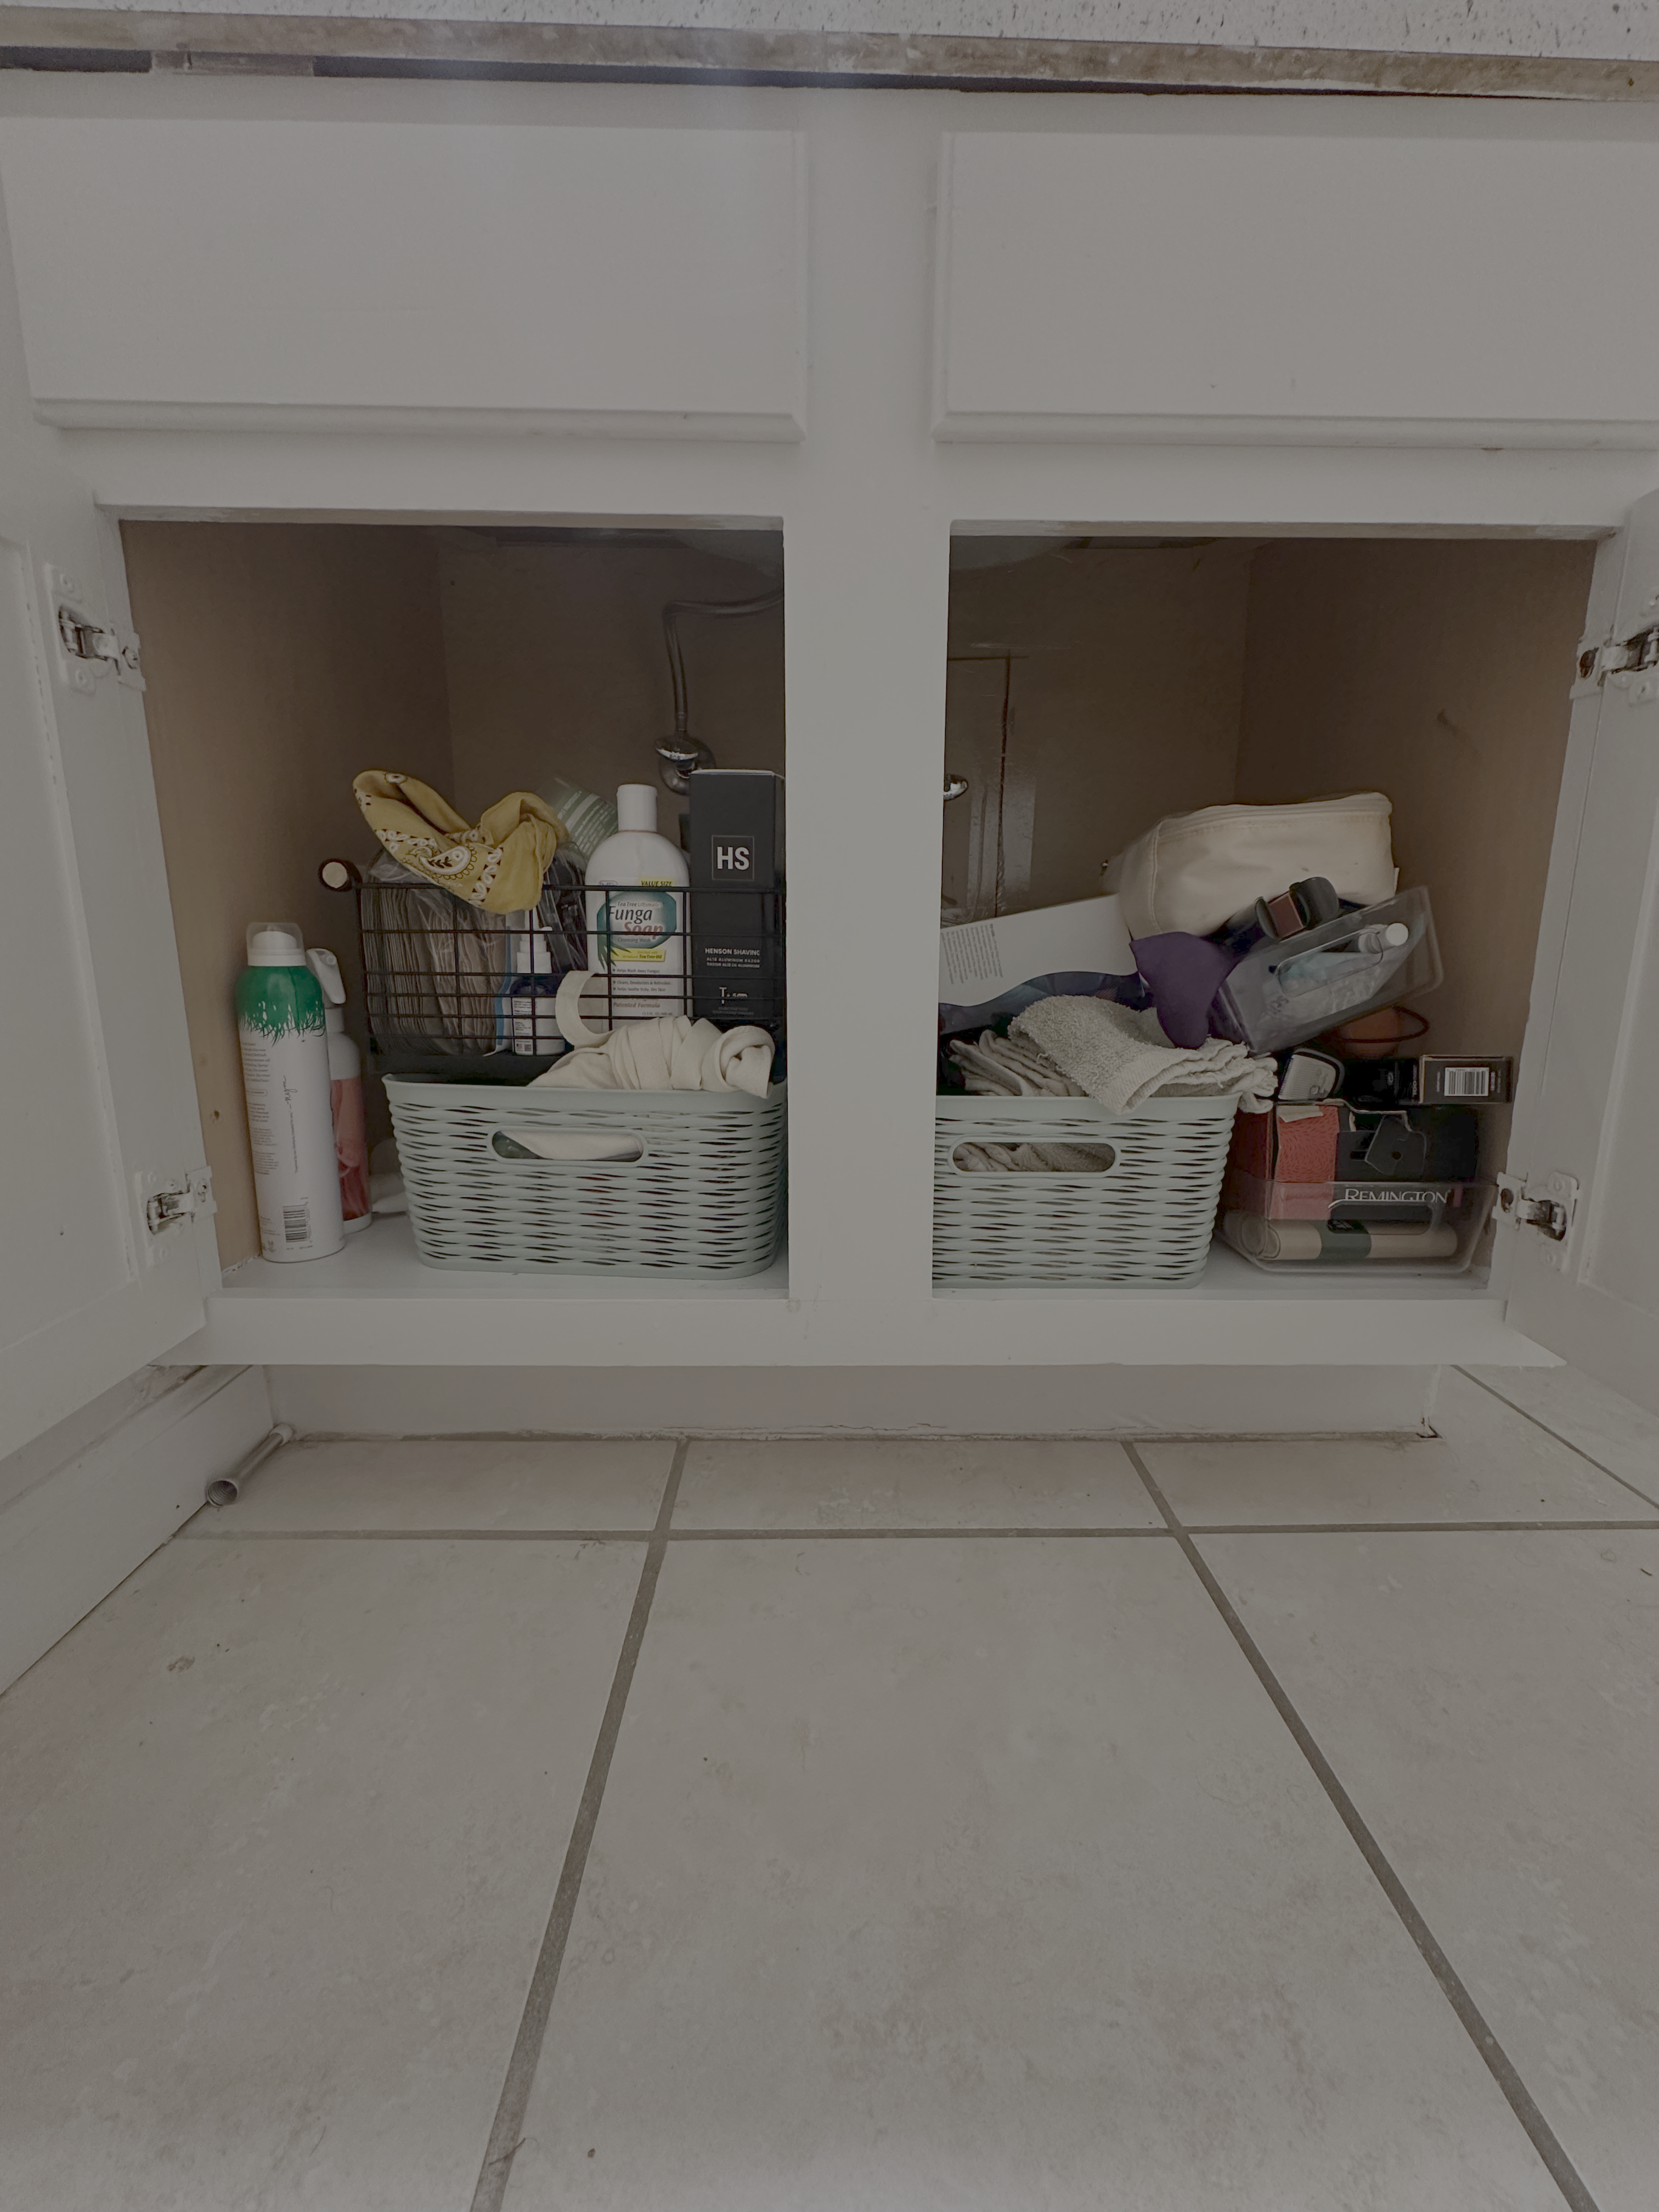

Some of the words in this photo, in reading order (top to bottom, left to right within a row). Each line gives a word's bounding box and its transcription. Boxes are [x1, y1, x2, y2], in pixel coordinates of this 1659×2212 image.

[716, 846, 750, 871] HS
[609, 906, 652, 924] Funga
[624, 922, 663, 940] Soap
[1345, 1188, 1448, 1203] REMINGTON
